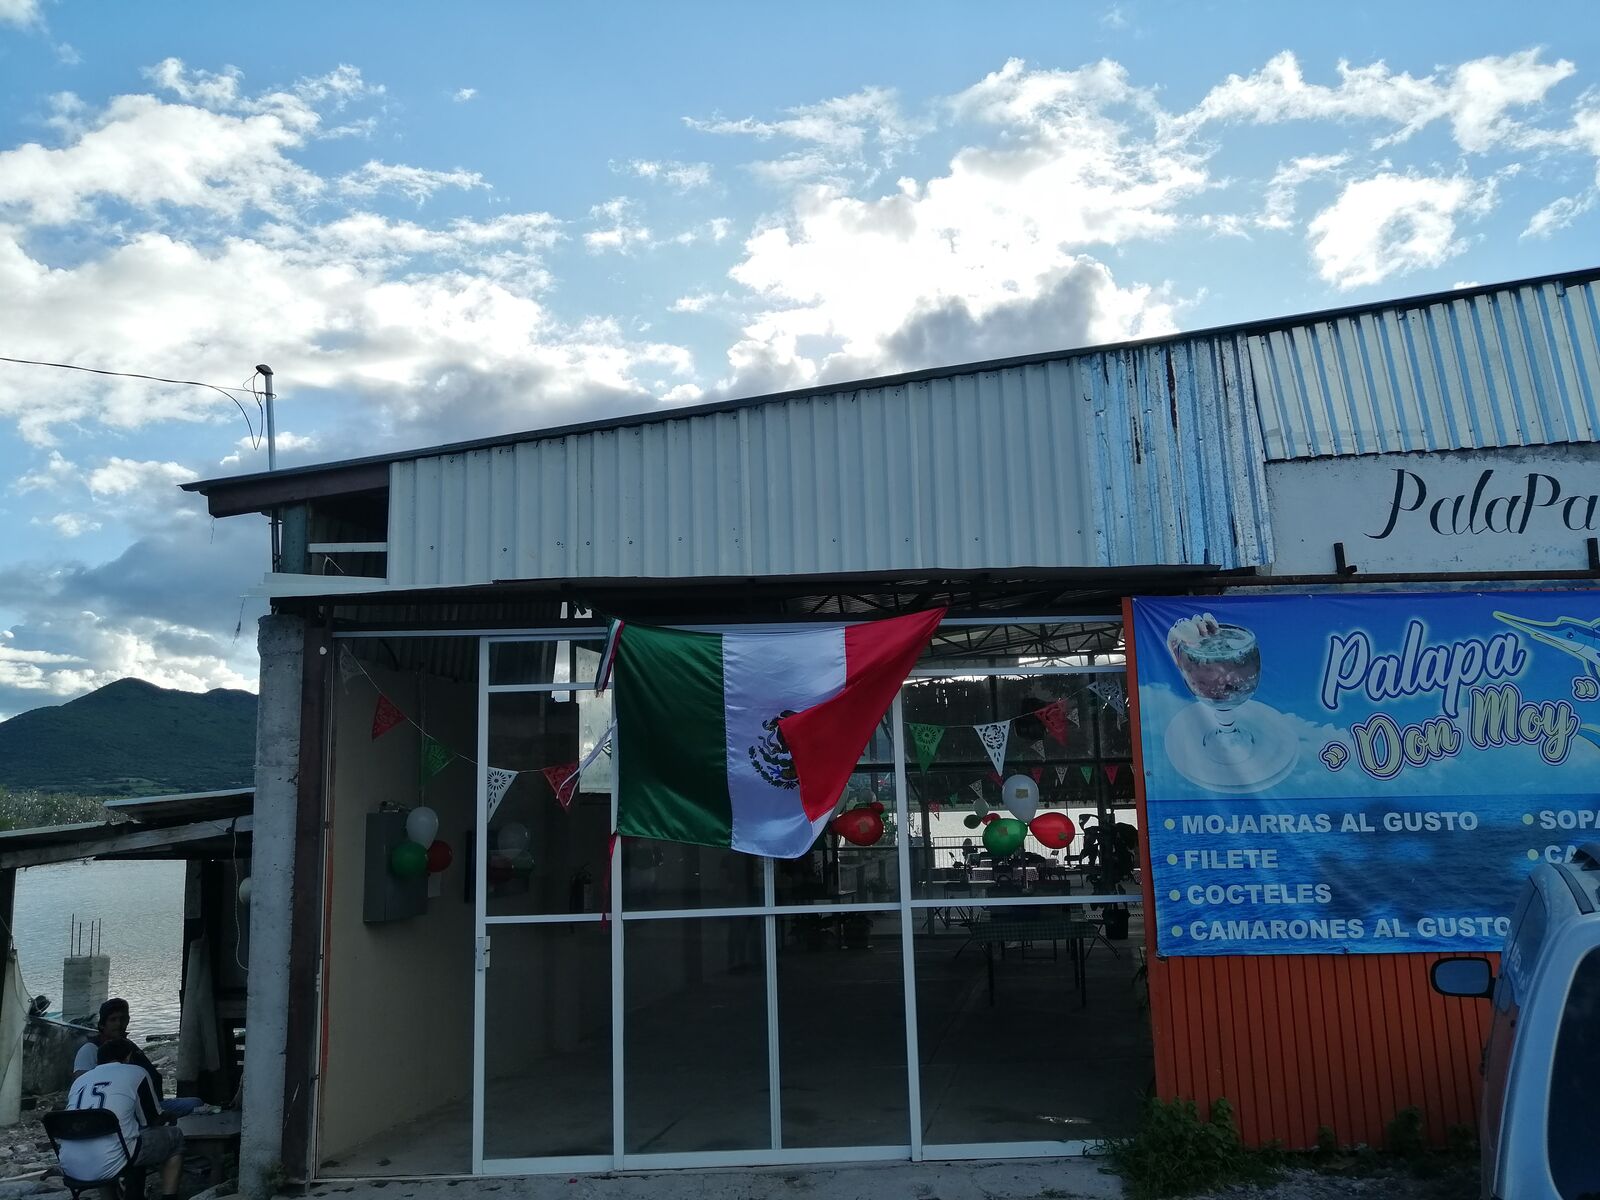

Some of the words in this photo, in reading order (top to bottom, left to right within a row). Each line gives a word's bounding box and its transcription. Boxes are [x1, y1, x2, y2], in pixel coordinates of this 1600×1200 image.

[1322, 620, 1527, 718] Palapa
[1182, 813, 1332, 834] MOJARRAS
[1341, 813, 1375, 832] AL
[1383, 811, 1478, 832] GUSTO
[1184, 849, 1278, 869] FILETE
[1187, 884, 1332, 905] COCTELES
[1190, 919, 1365, 940] CAMARONES
[1374, 918, 1409, 938] AL
[1417, 917, 1511, 937] GUSTO
[76, 1081, 112, 1109] 15
